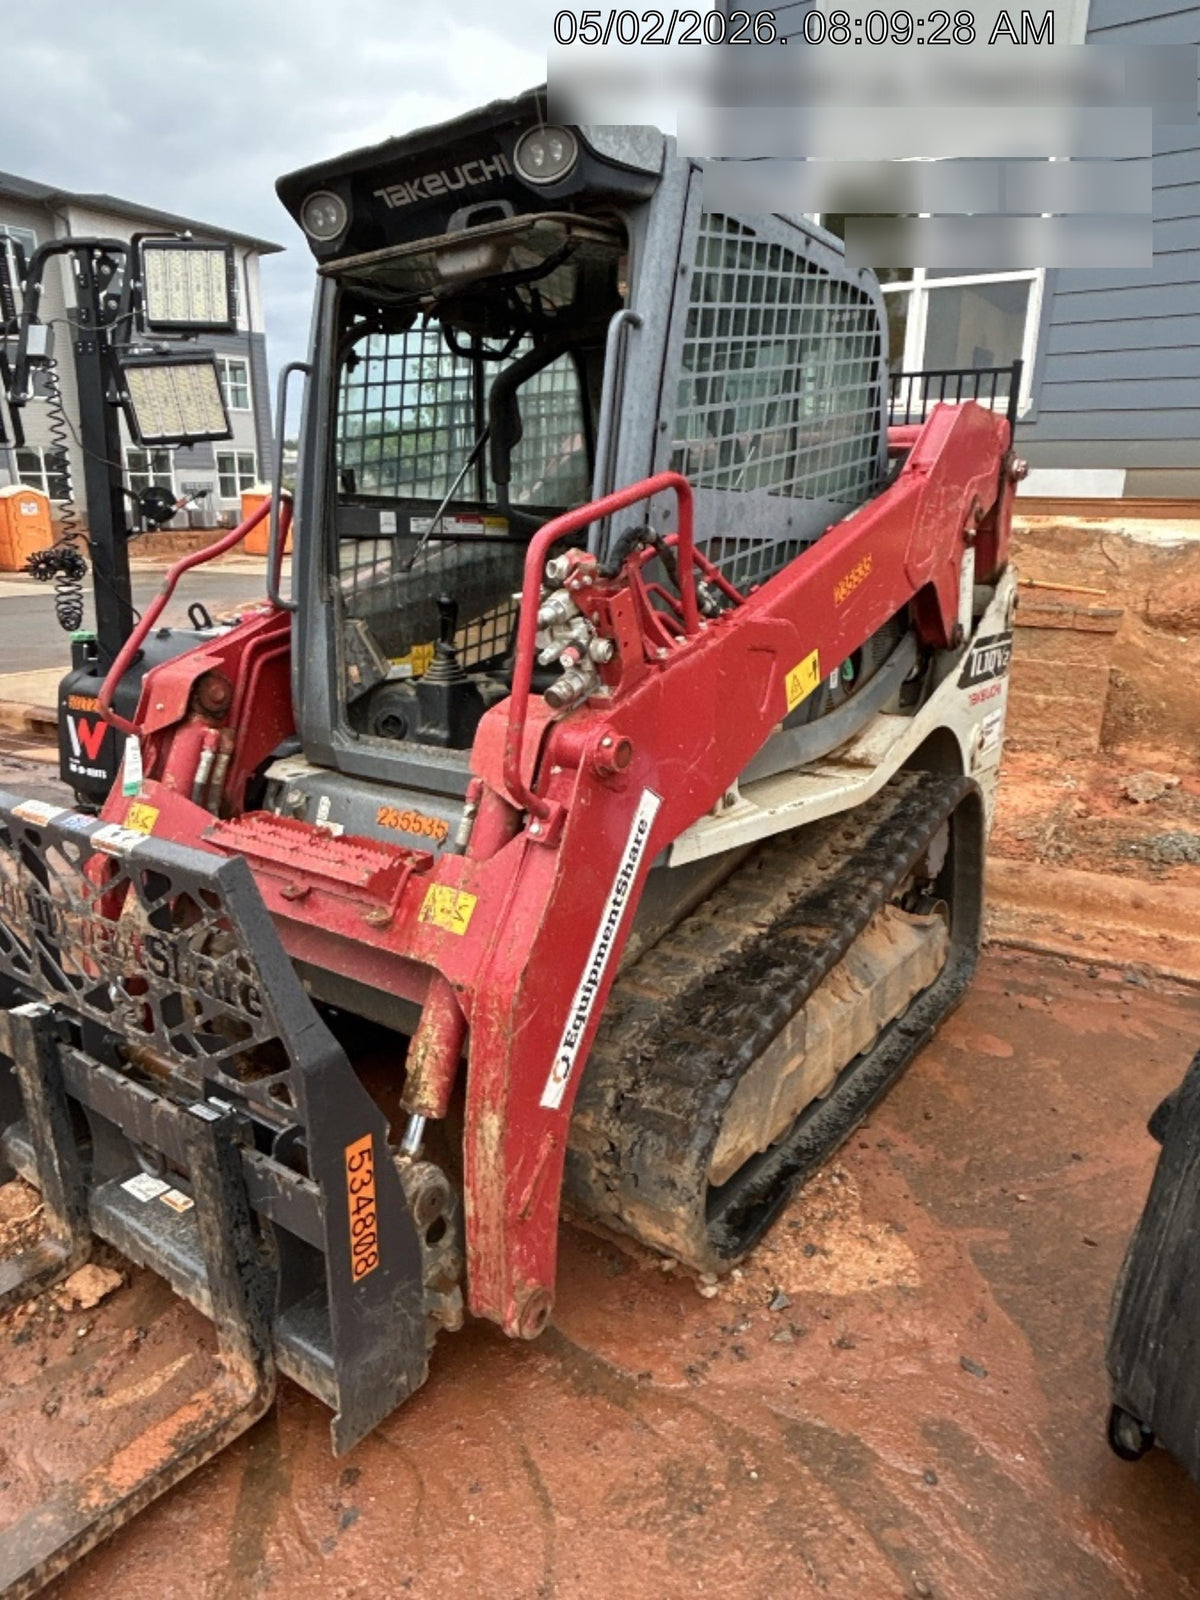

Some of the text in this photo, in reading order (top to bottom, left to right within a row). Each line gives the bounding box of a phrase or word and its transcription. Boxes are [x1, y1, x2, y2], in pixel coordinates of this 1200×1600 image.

[377, 805, 447, 840] 235535
[563, 818, 649, 1050] EquipmentShare
[347, 1148, 378, 1277] 534808
